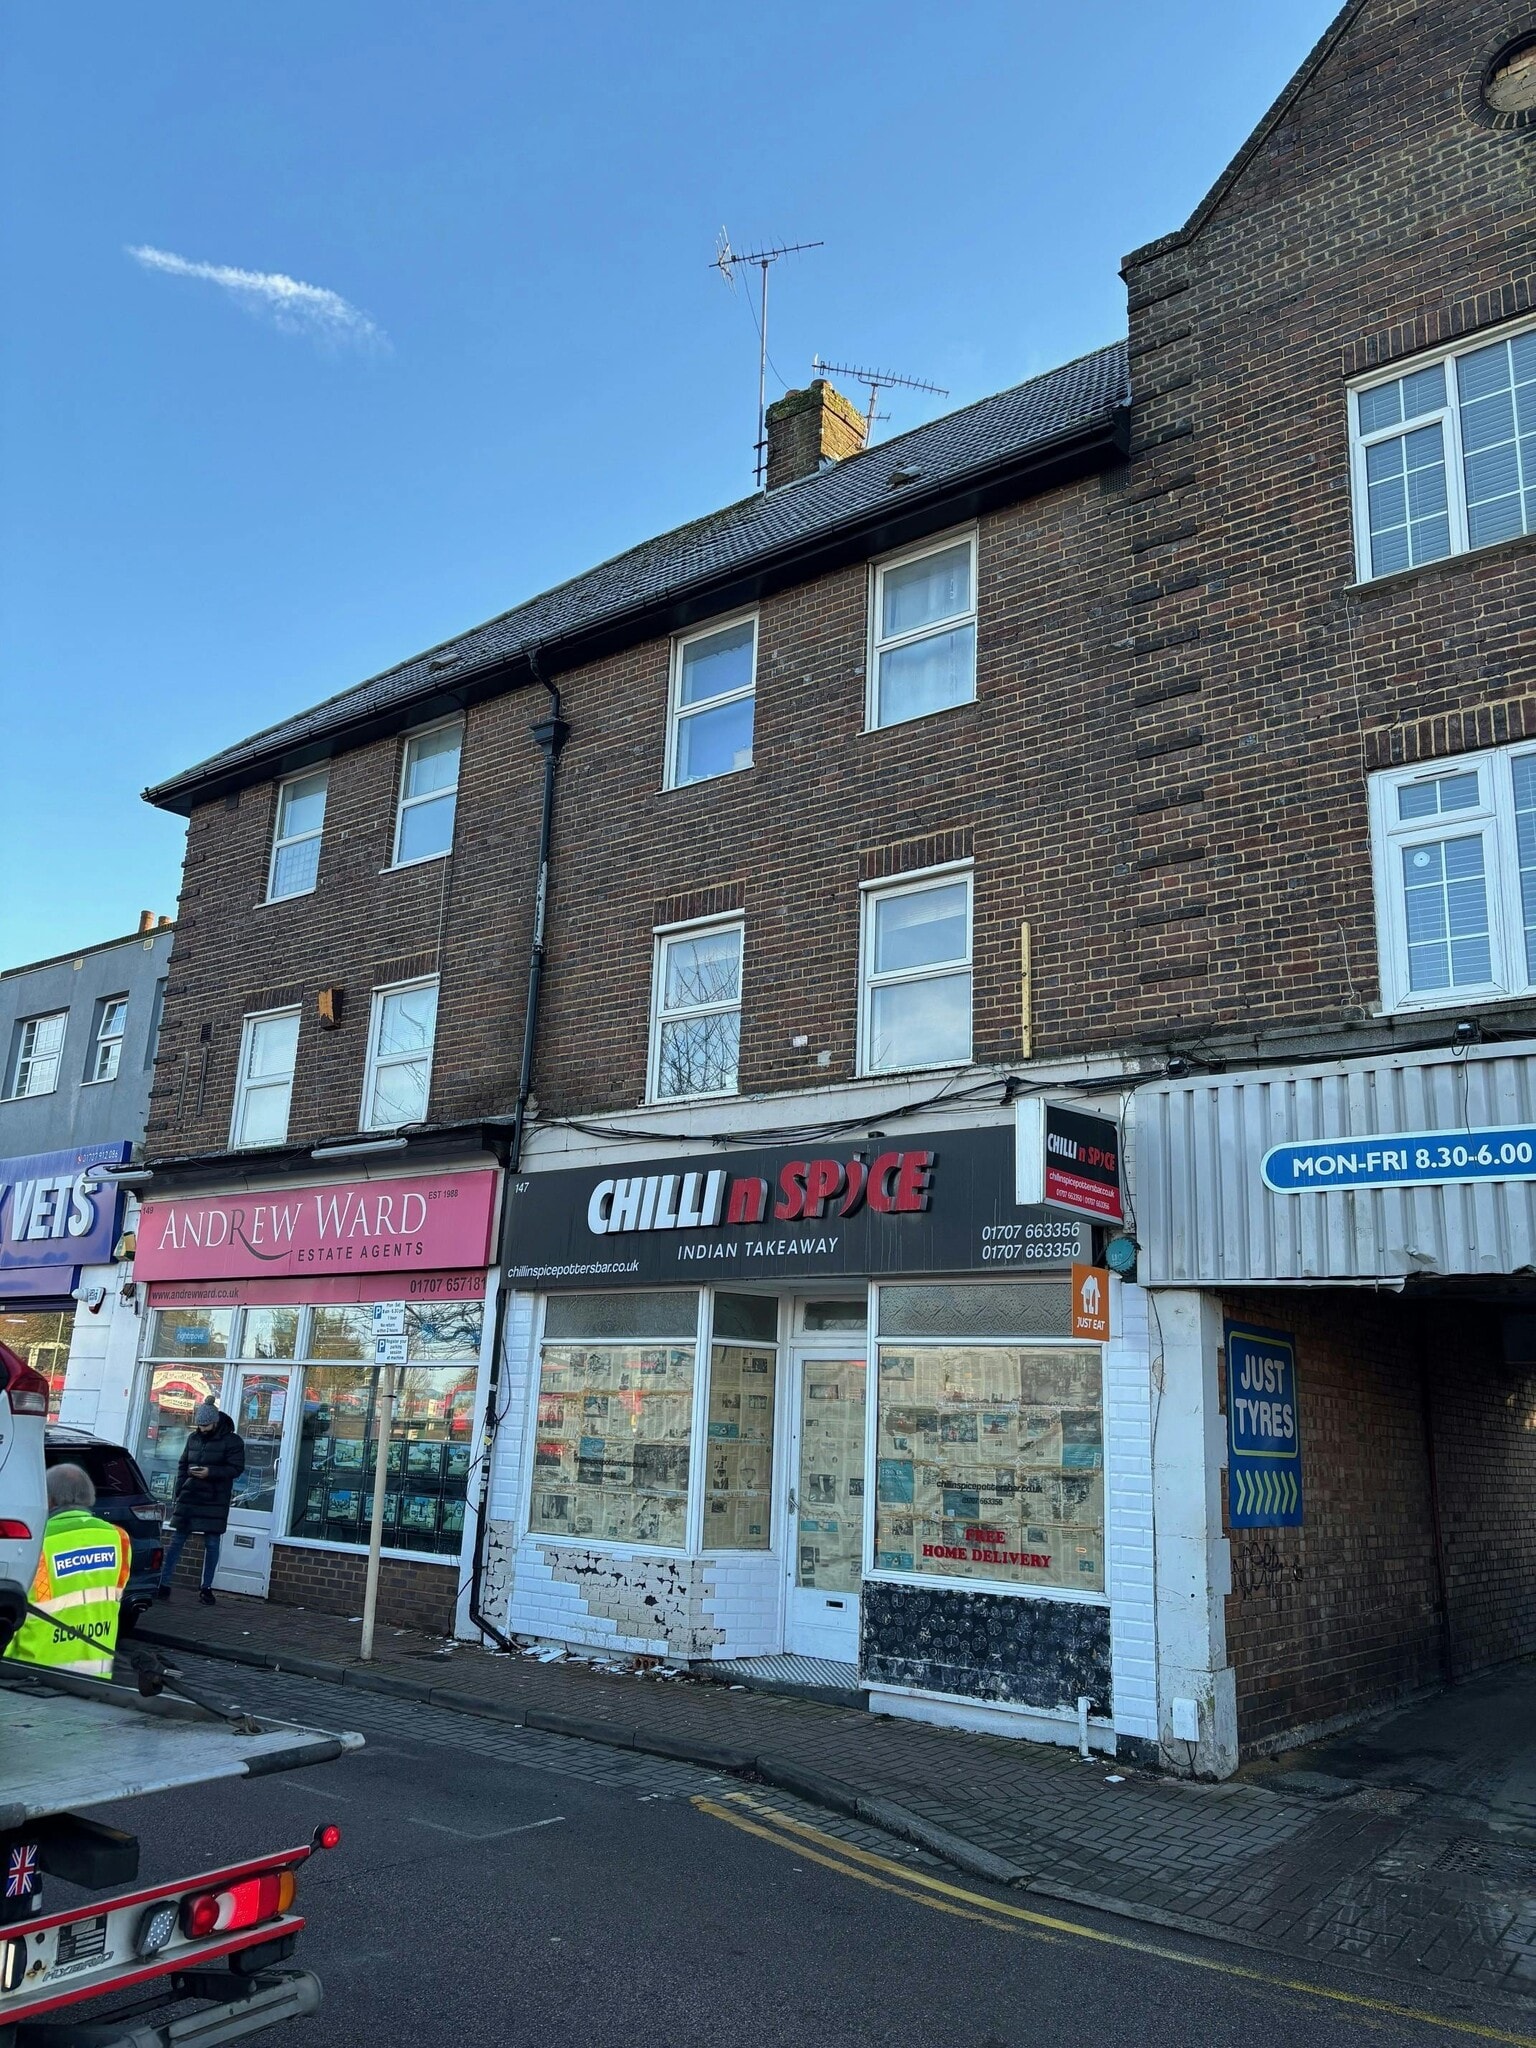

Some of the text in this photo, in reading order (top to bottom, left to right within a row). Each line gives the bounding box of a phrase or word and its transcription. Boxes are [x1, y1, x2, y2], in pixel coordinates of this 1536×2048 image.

[1047, 1133, 1116, 1171] CHILLI n SPICE
[1293, 1142, 1532, 1178] MON-FRI 8.30-6.00
[429, 1189, 459, 1199] EST 1988
[515, 1182, 529, 1193] 147
[587, 1150, 934, 1235] CHILLI n SPICE
[12, 1173, 95, 1240] VETS
[143, 1206, 154, 1215] 149
[157, 1192, 427, 1260] ANDREW WARD
[982, 1222, 1081, 1240] 01707 663356
[298, 1242, 423, 1262] ESTATE AGENTS
[677, 1237, 839, 1260] INDIAN TAKEAWAY
[982, 1242, 1081, 1260] 01707 663350
[507, 1259, 640, 1279] chillinspicepottersbar.co.uk
[152, 1288, 239, 1300] www.andrewward.co.uk
[410, 1277, 486, 1293] 01707 657181
[375, 1306, 382, 1319] P
[1077, 1316, 1106, 1331] JUST EAT
[379, 1340, 385, 1352] P
[1240, 1353, 1285, 1394] JUST
[1235, 1398, 1294, 1438] TYRES
[965, 1528, 1006, 1544] FREE
[57, 1552, 115, 1570] RECOVERY
[922, 1544, 1052, 1568] HOME DELIVERY
